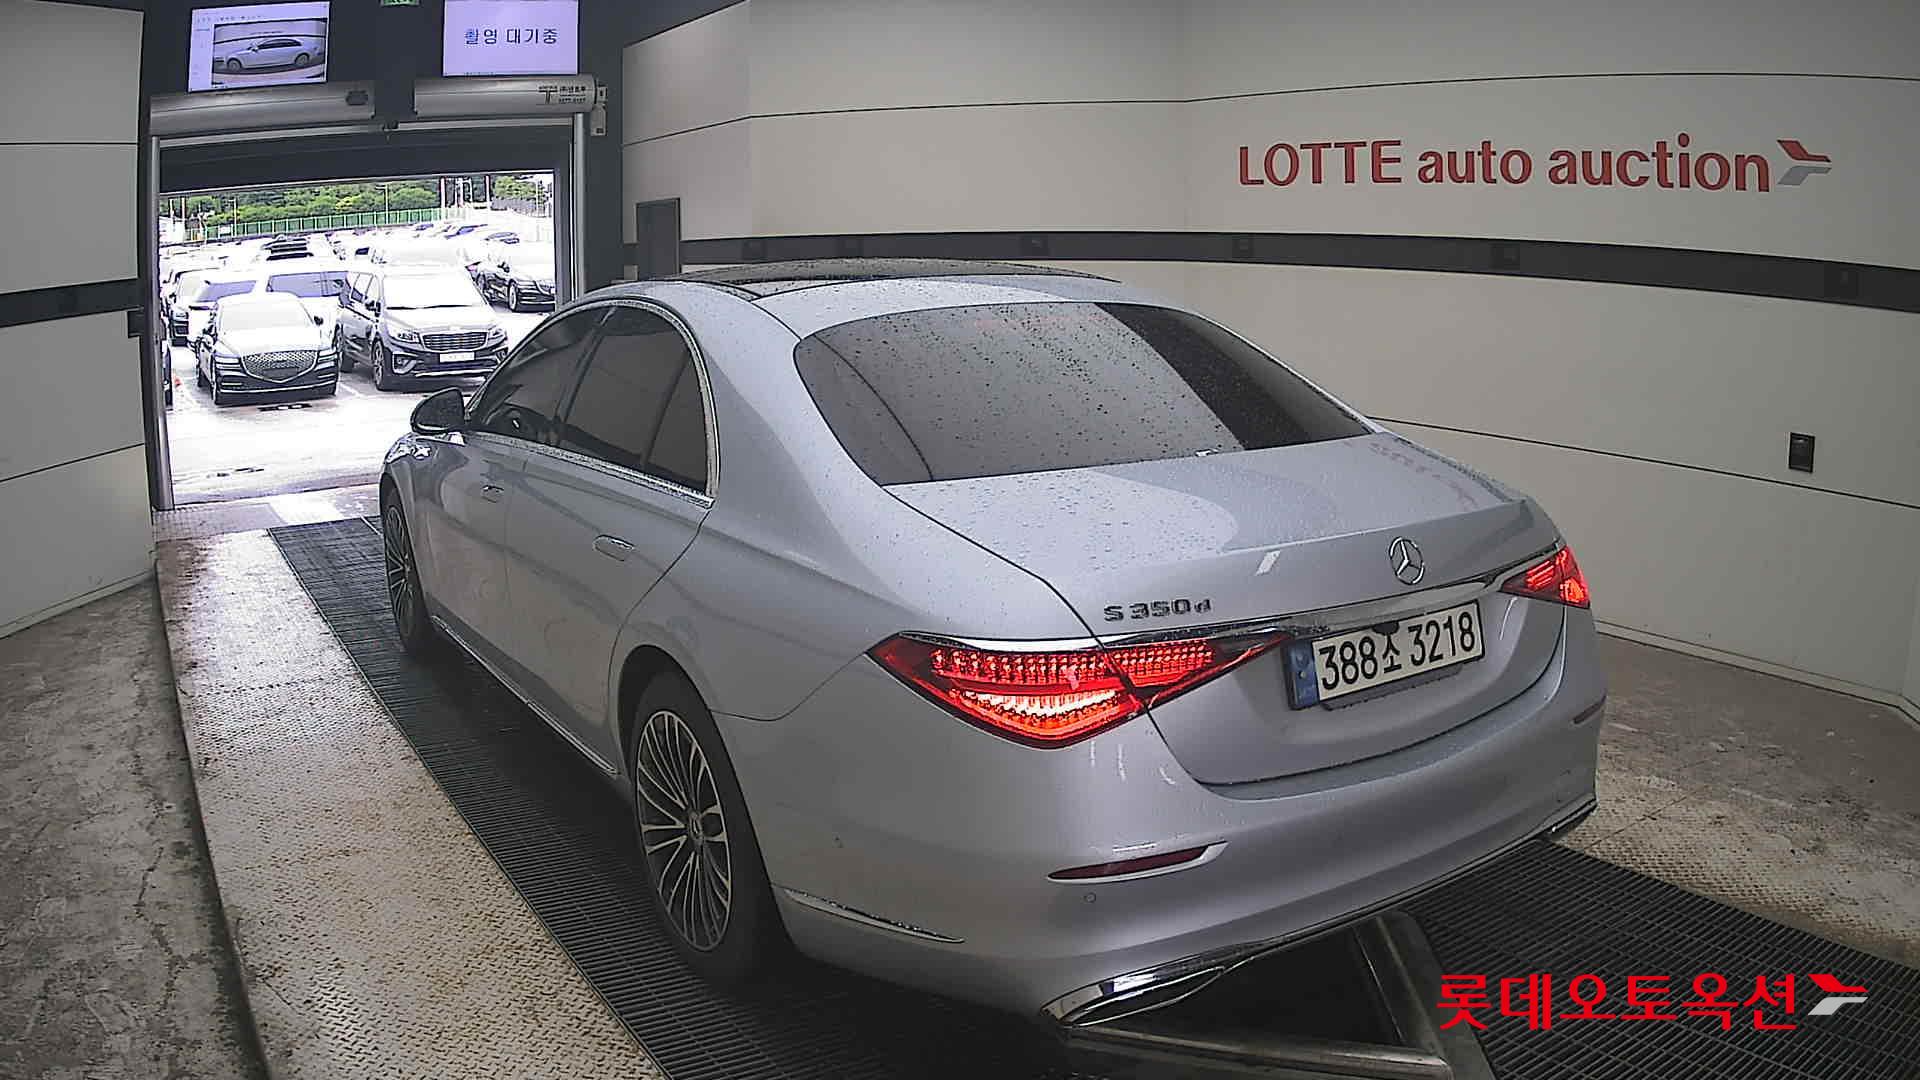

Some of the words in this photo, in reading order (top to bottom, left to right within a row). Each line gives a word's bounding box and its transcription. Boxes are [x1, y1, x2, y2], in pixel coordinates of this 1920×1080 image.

[506, 28, 558, 45] 대기중
[1239, 139, 1402, 186] LOTTE
[1417, 140, 1533, 185] auto
[1548, 132, 1771, 193] auction
[1104, 605, 1124, 622] S
[1319, 634, 1402, 690] 388소
[1408, 611, 1476, 666] 3218
